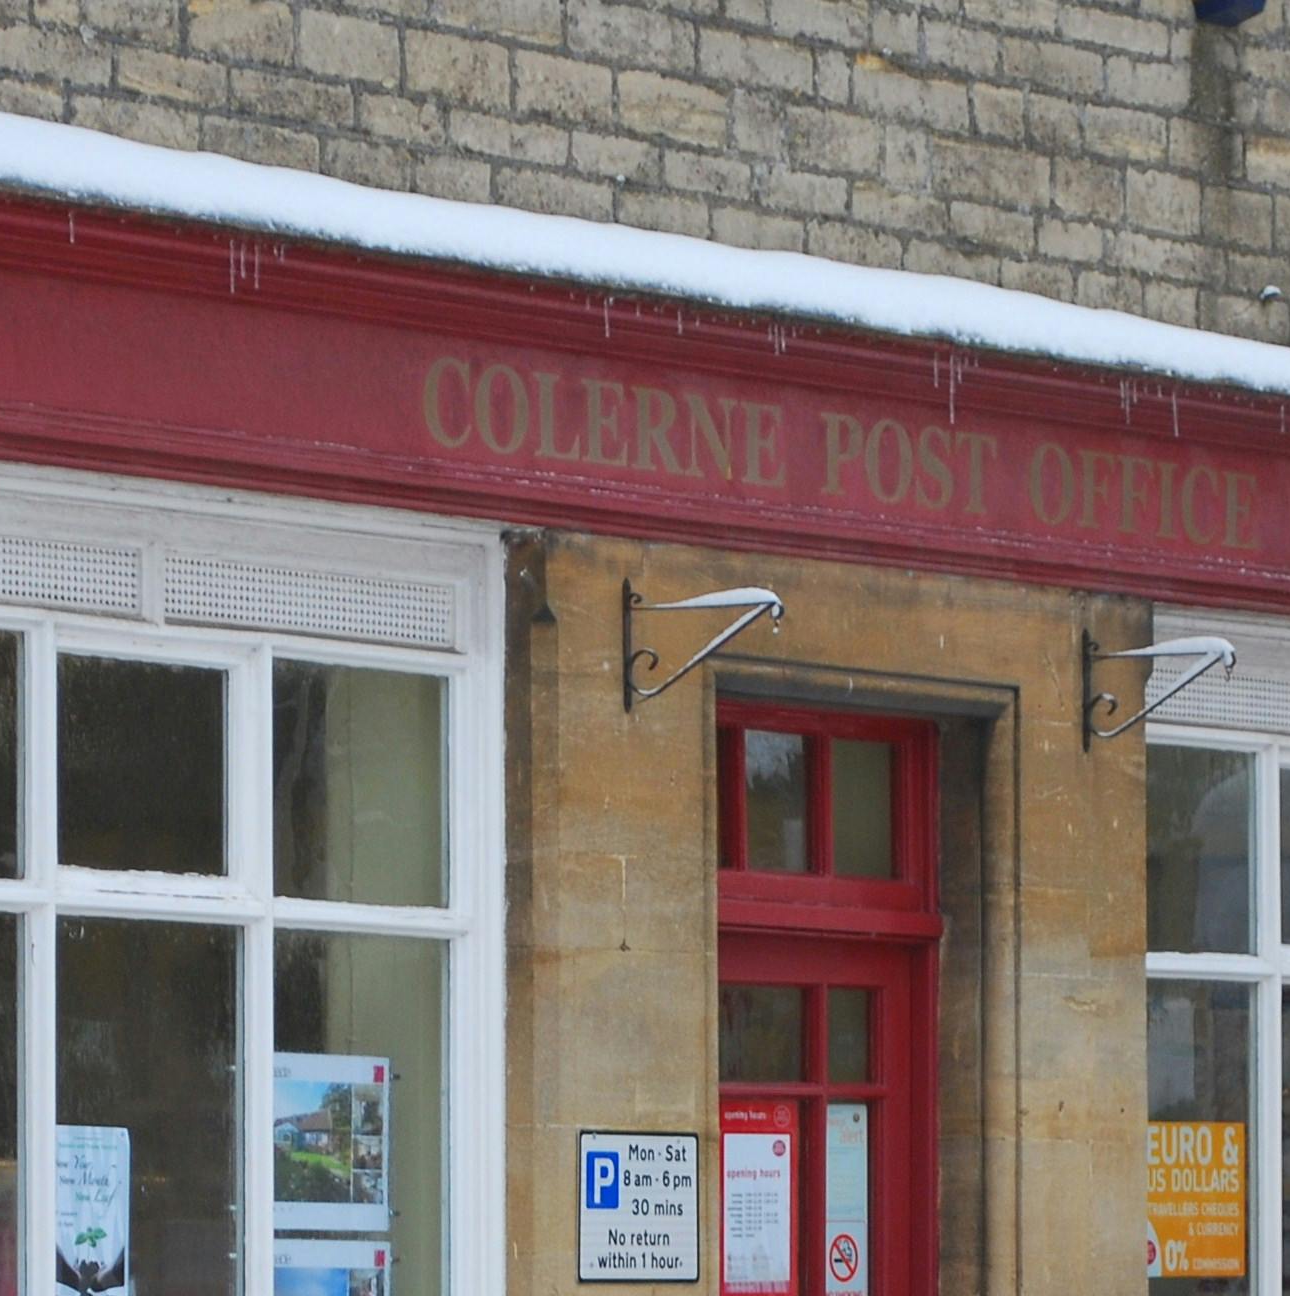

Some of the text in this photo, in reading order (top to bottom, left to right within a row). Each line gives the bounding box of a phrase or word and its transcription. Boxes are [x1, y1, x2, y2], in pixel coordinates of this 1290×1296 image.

[423, 356, 1260, 550] COLERNE POST OFFICE
[628, 1144, 655, 1161] Mon
[665, 1145, 687, 1162] Sat
[1147, 1126, 1239, 1166] EURO &
[593, 1157, 615, 1204] P
[726, 1167, 781, 1180] opening hours
[1147, 1168, 1240, 1193] US DOLLARS
[632, 1198, 684, 1216] 30 mins
[608, 1228, 670, 1246] No return
[597, 1252, 679, 1269] within 1 hour
[1165, 1239, 1189, 1271] 0%
